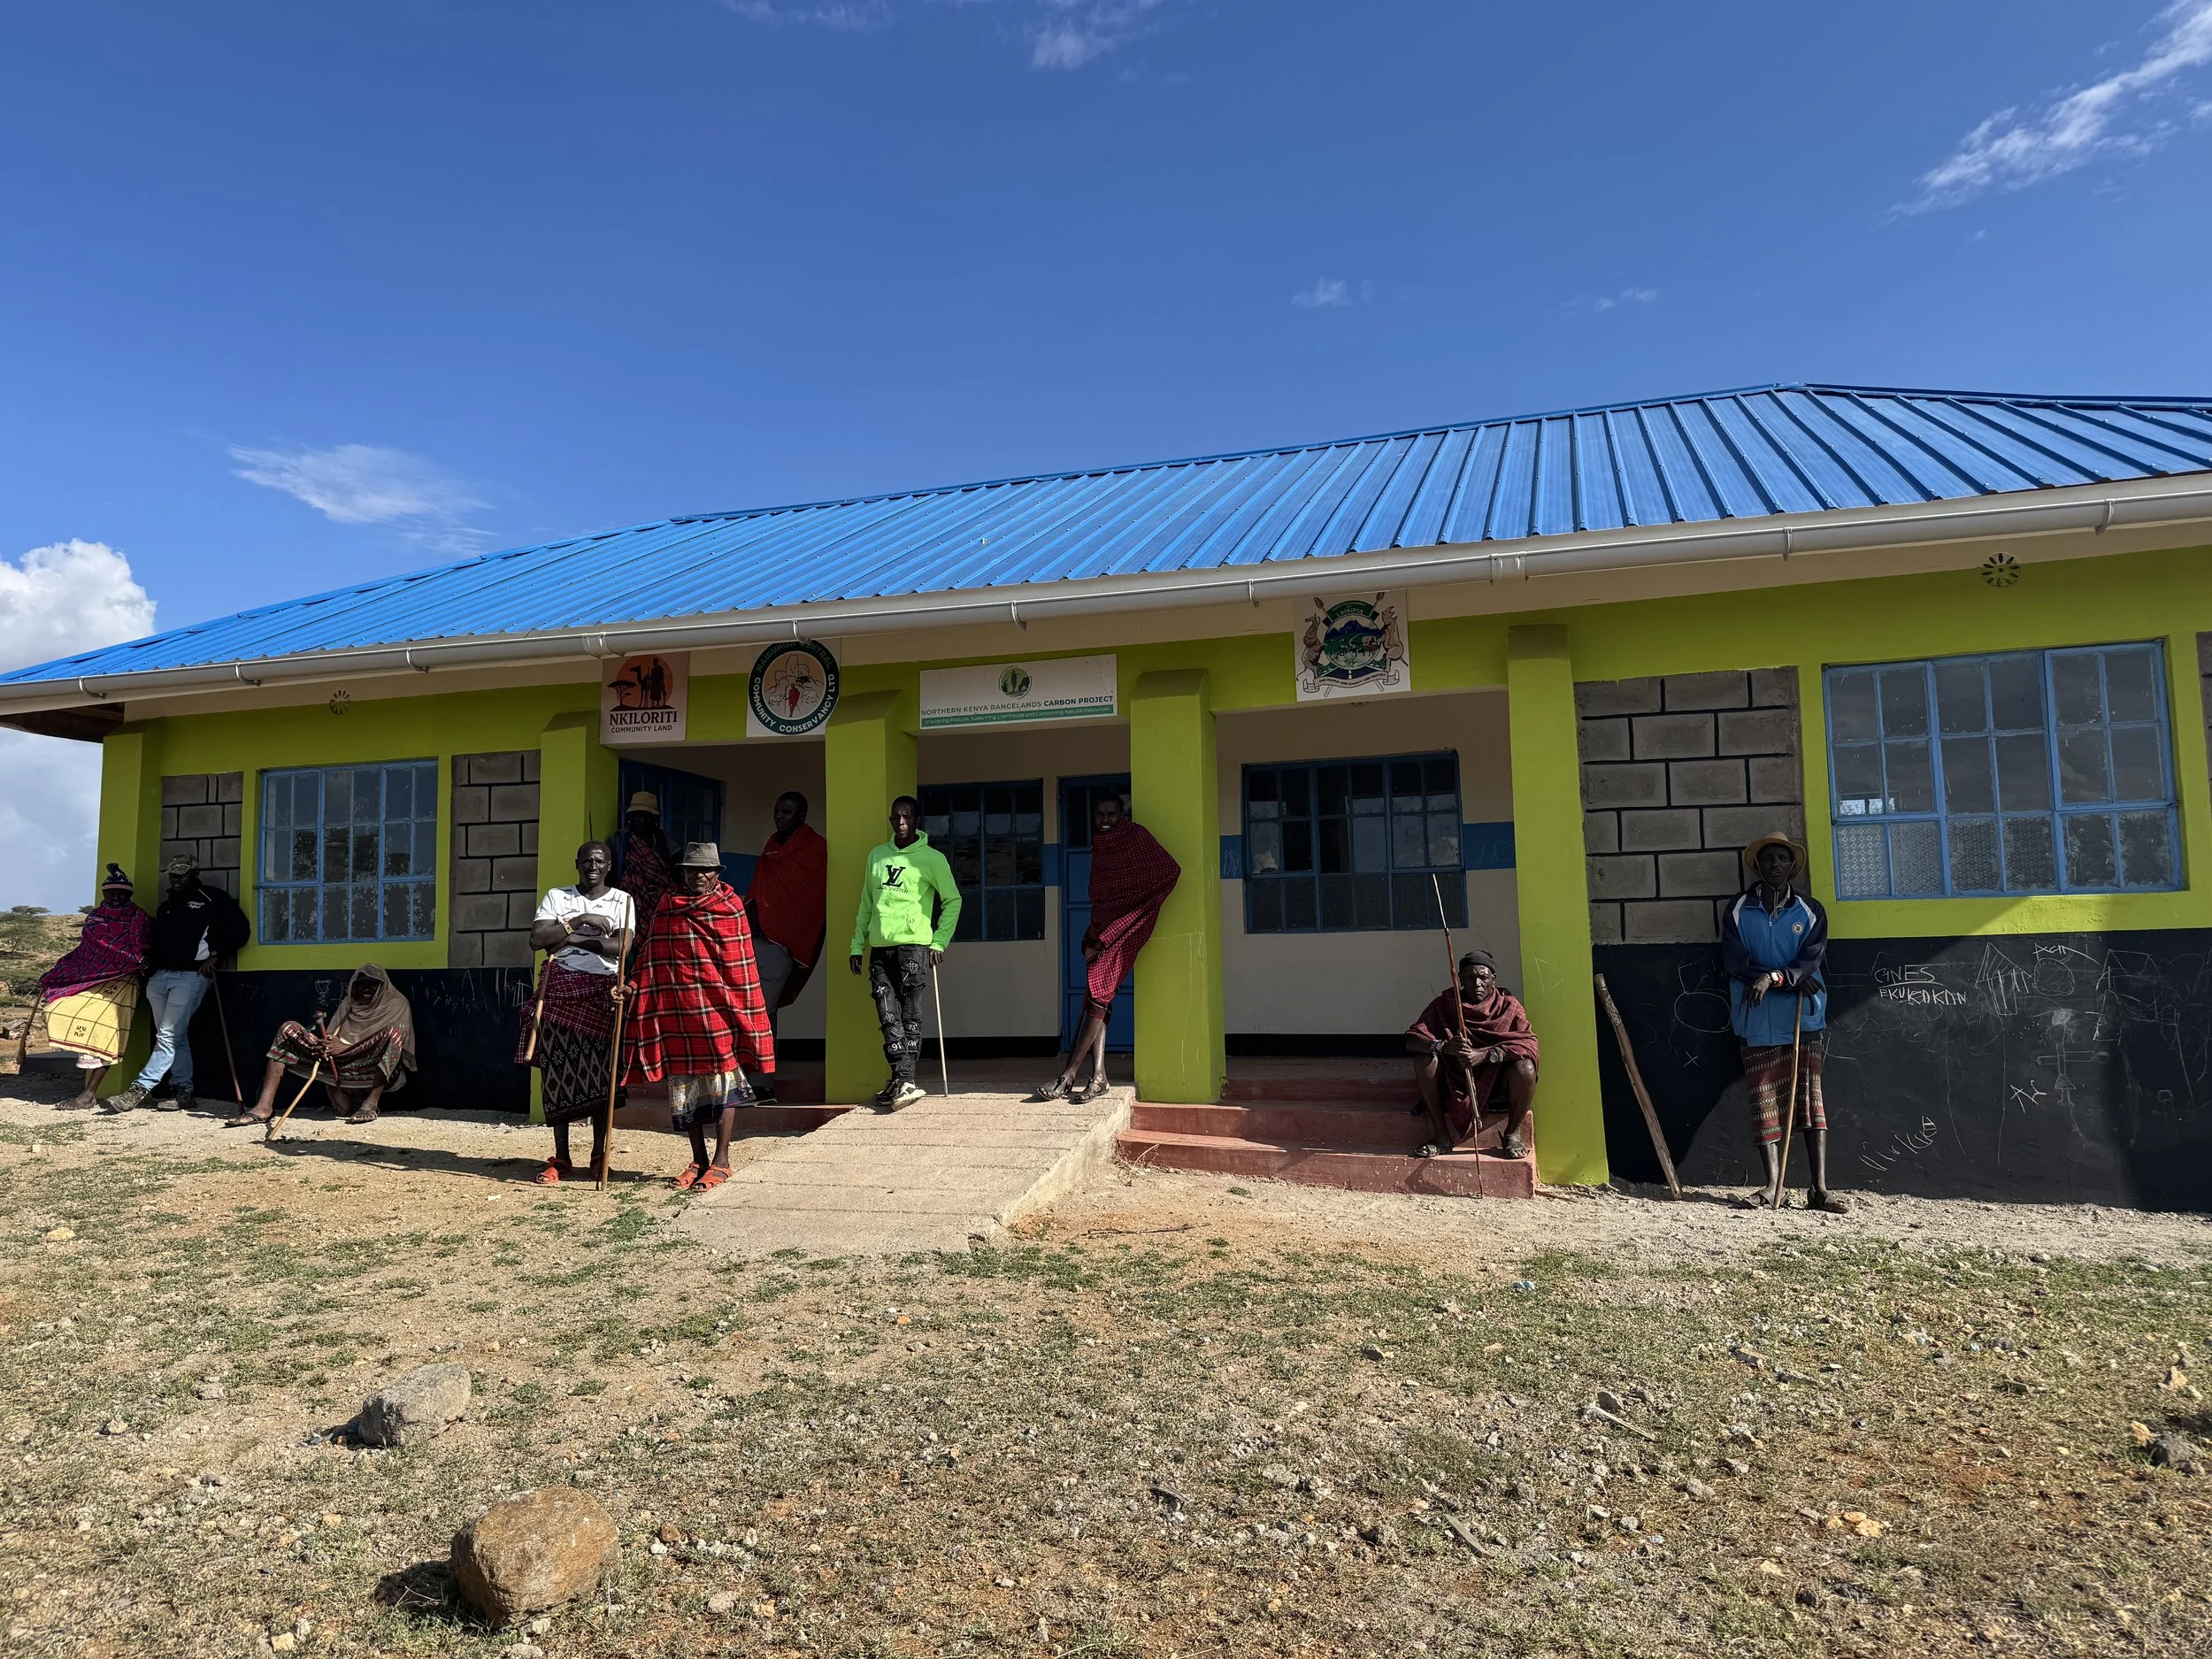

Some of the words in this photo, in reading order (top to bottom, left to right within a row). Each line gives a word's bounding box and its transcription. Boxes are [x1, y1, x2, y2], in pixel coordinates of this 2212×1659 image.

[1336, 607, 1363, 617] LAIKIPIA
[753, 677, 776, 726] COMMUNITY
[779, 694, 833, 733] CONSERVANCY
[921, 707, 962, 716] NORTHERN
[990, 701, 1042, 710] RANGELANDS
[1043, 698, 1076, 707] CARBON
[1078, 695, 1113, 704] PROJECT
[610, 710, 678, 726] NKILORITI
